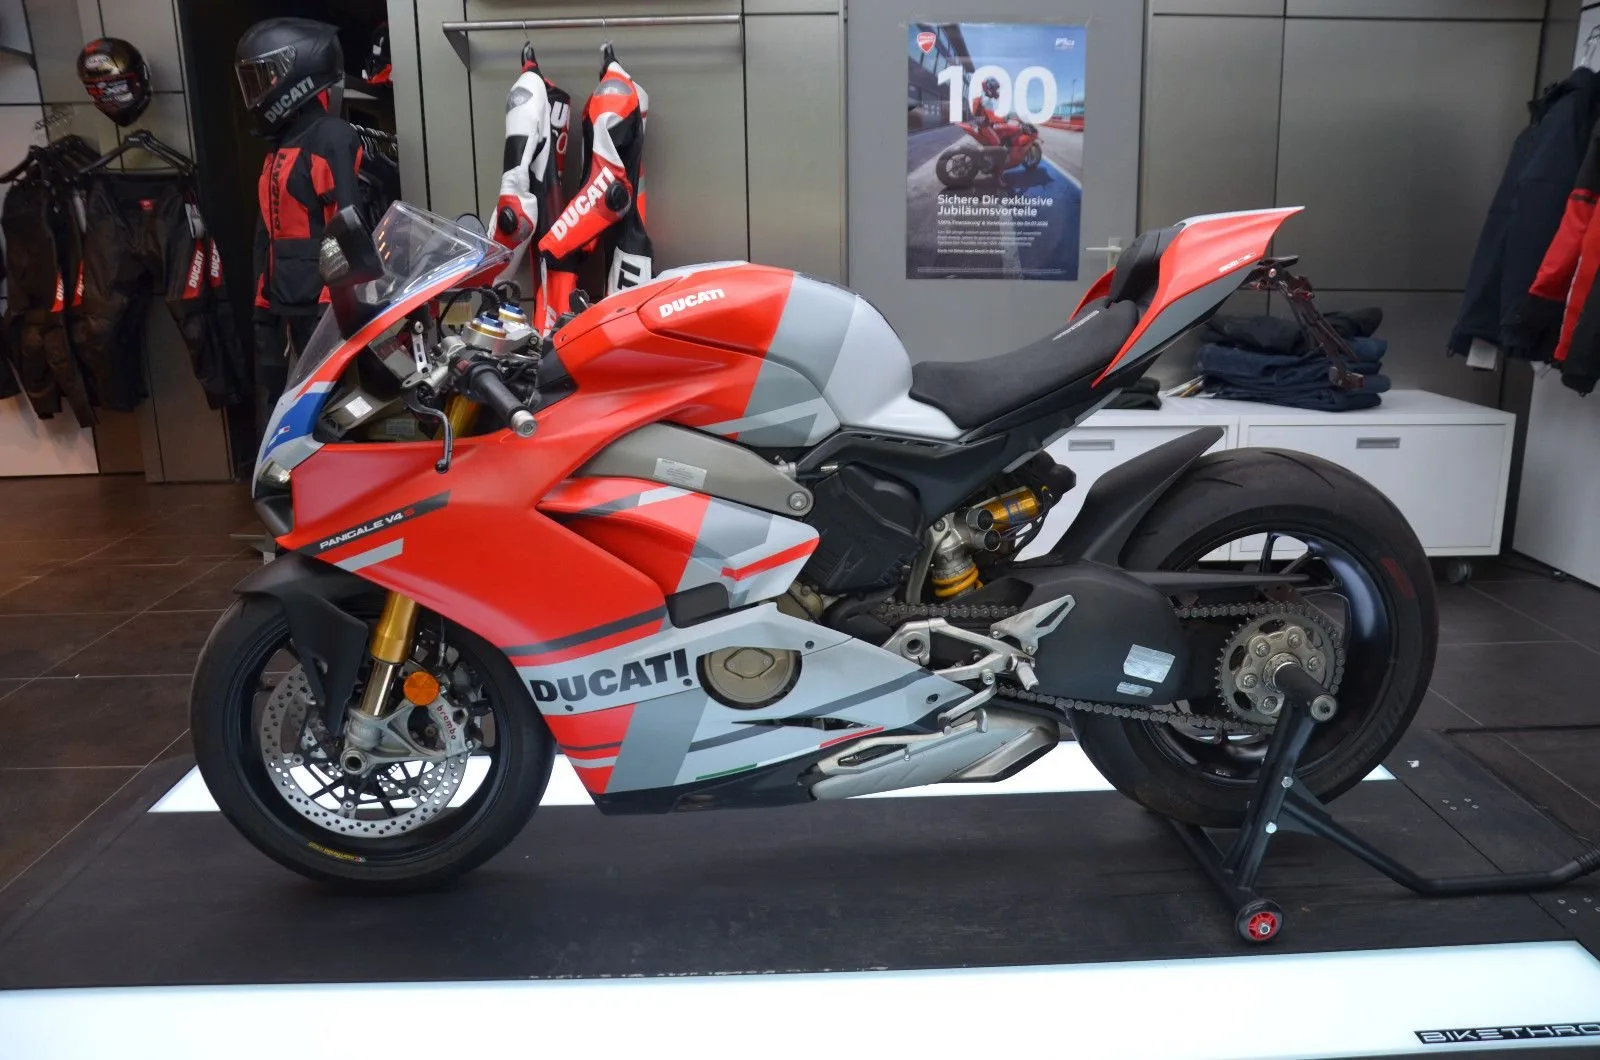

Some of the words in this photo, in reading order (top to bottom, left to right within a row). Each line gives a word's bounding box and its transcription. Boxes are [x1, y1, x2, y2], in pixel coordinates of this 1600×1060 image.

[264, 75, 315, 124] DUCATI
[937, 65, 1058, 124] 100
[551, 166, 616, 241] DUCATI
[937, 194, 979, 205] Sichere
[982, 194, 999, 205] Dir
[1001, 195, 1054, 207] exklusive
[937, 205, 1038, 216] Jubiläumsvorteile
[188, 250, 204, 289] DUCATI
[659, 288, 726, 319] DUCATI
[320, 520, 384, 549] PANIGALE
[529, 648, 691, 702] DUCATI
[436, 705, 457, 740] brembo
[1420, 1023, 1600, 1043] BIKETHRO
